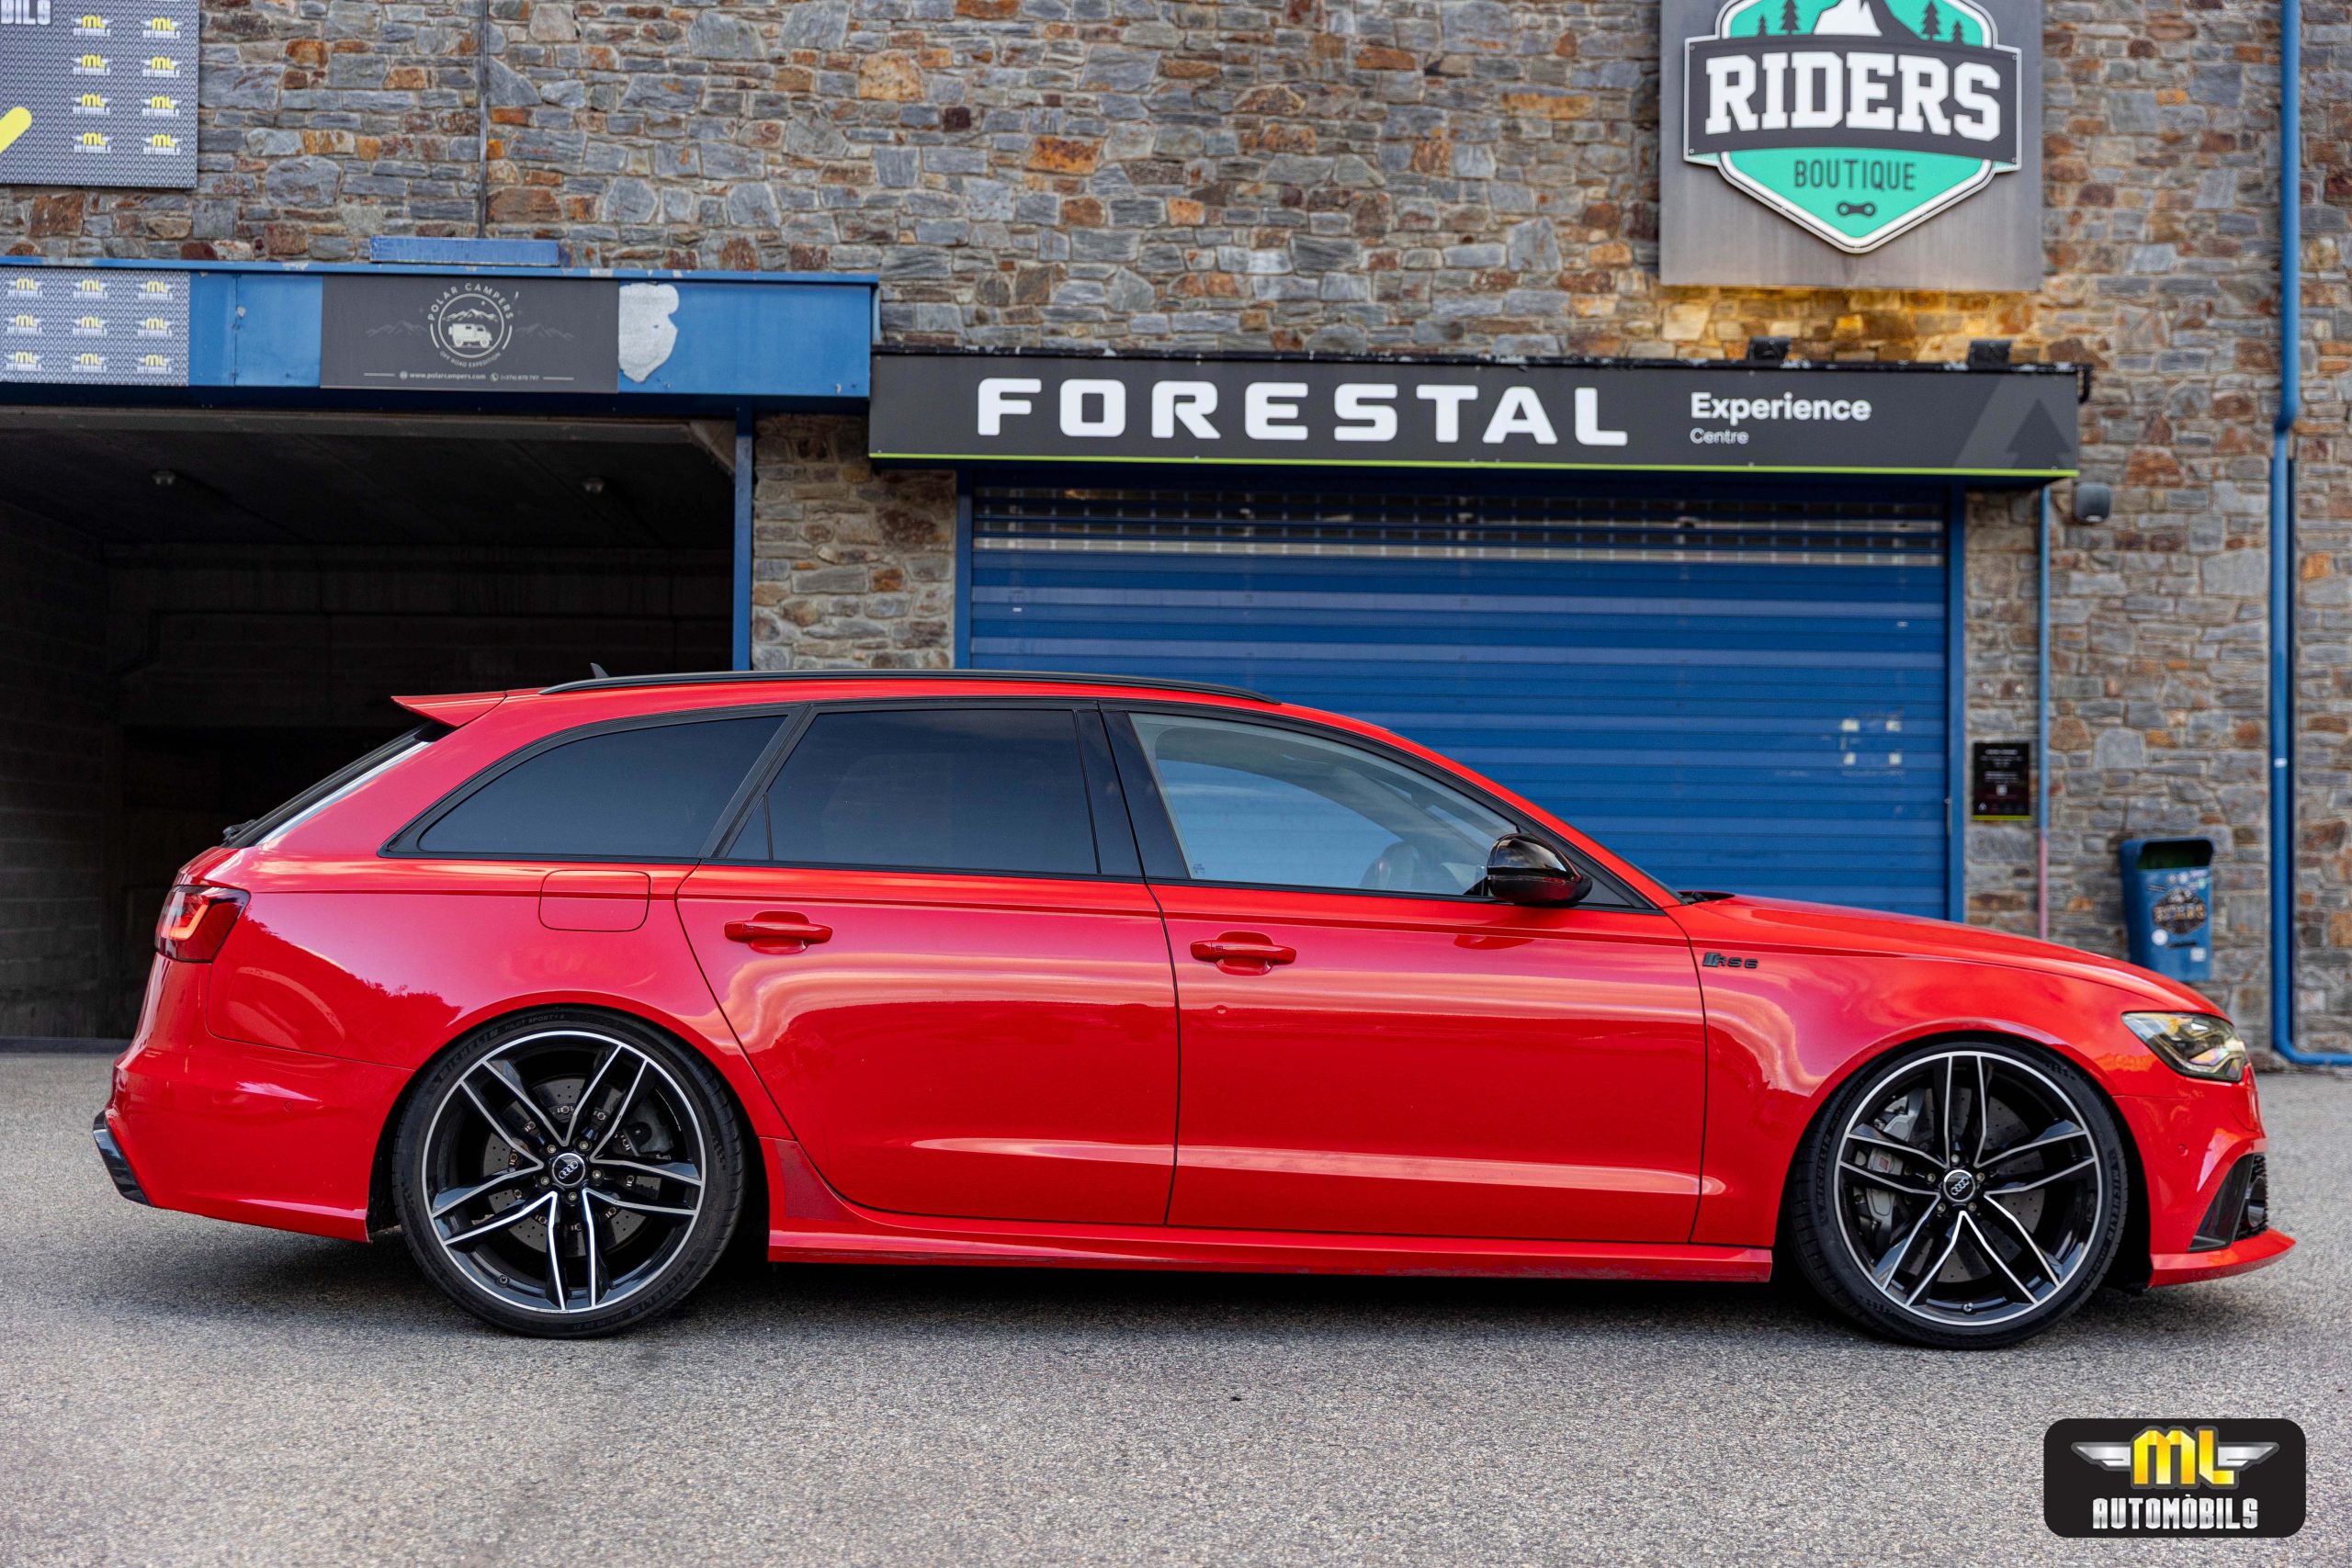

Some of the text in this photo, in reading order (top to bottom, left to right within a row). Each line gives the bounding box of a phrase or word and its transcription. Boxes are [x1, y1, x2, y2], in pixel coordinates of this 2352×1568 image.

[1705, 51, 2001, 141] RIDERS
[1794, 159, 1916, 191] BOUTIQUE
[427, 282, 514, 321] POLAR CAMPERS
[410, 371, 486, 380] www.polarcampers.com
[978, 378, 1628, 446] FORESTAL
[1690, 391, 1872, 426] Experience
[1690, 427, 1749, 445] Centre
[439, 1028, 499, 1080] MICHELIN
